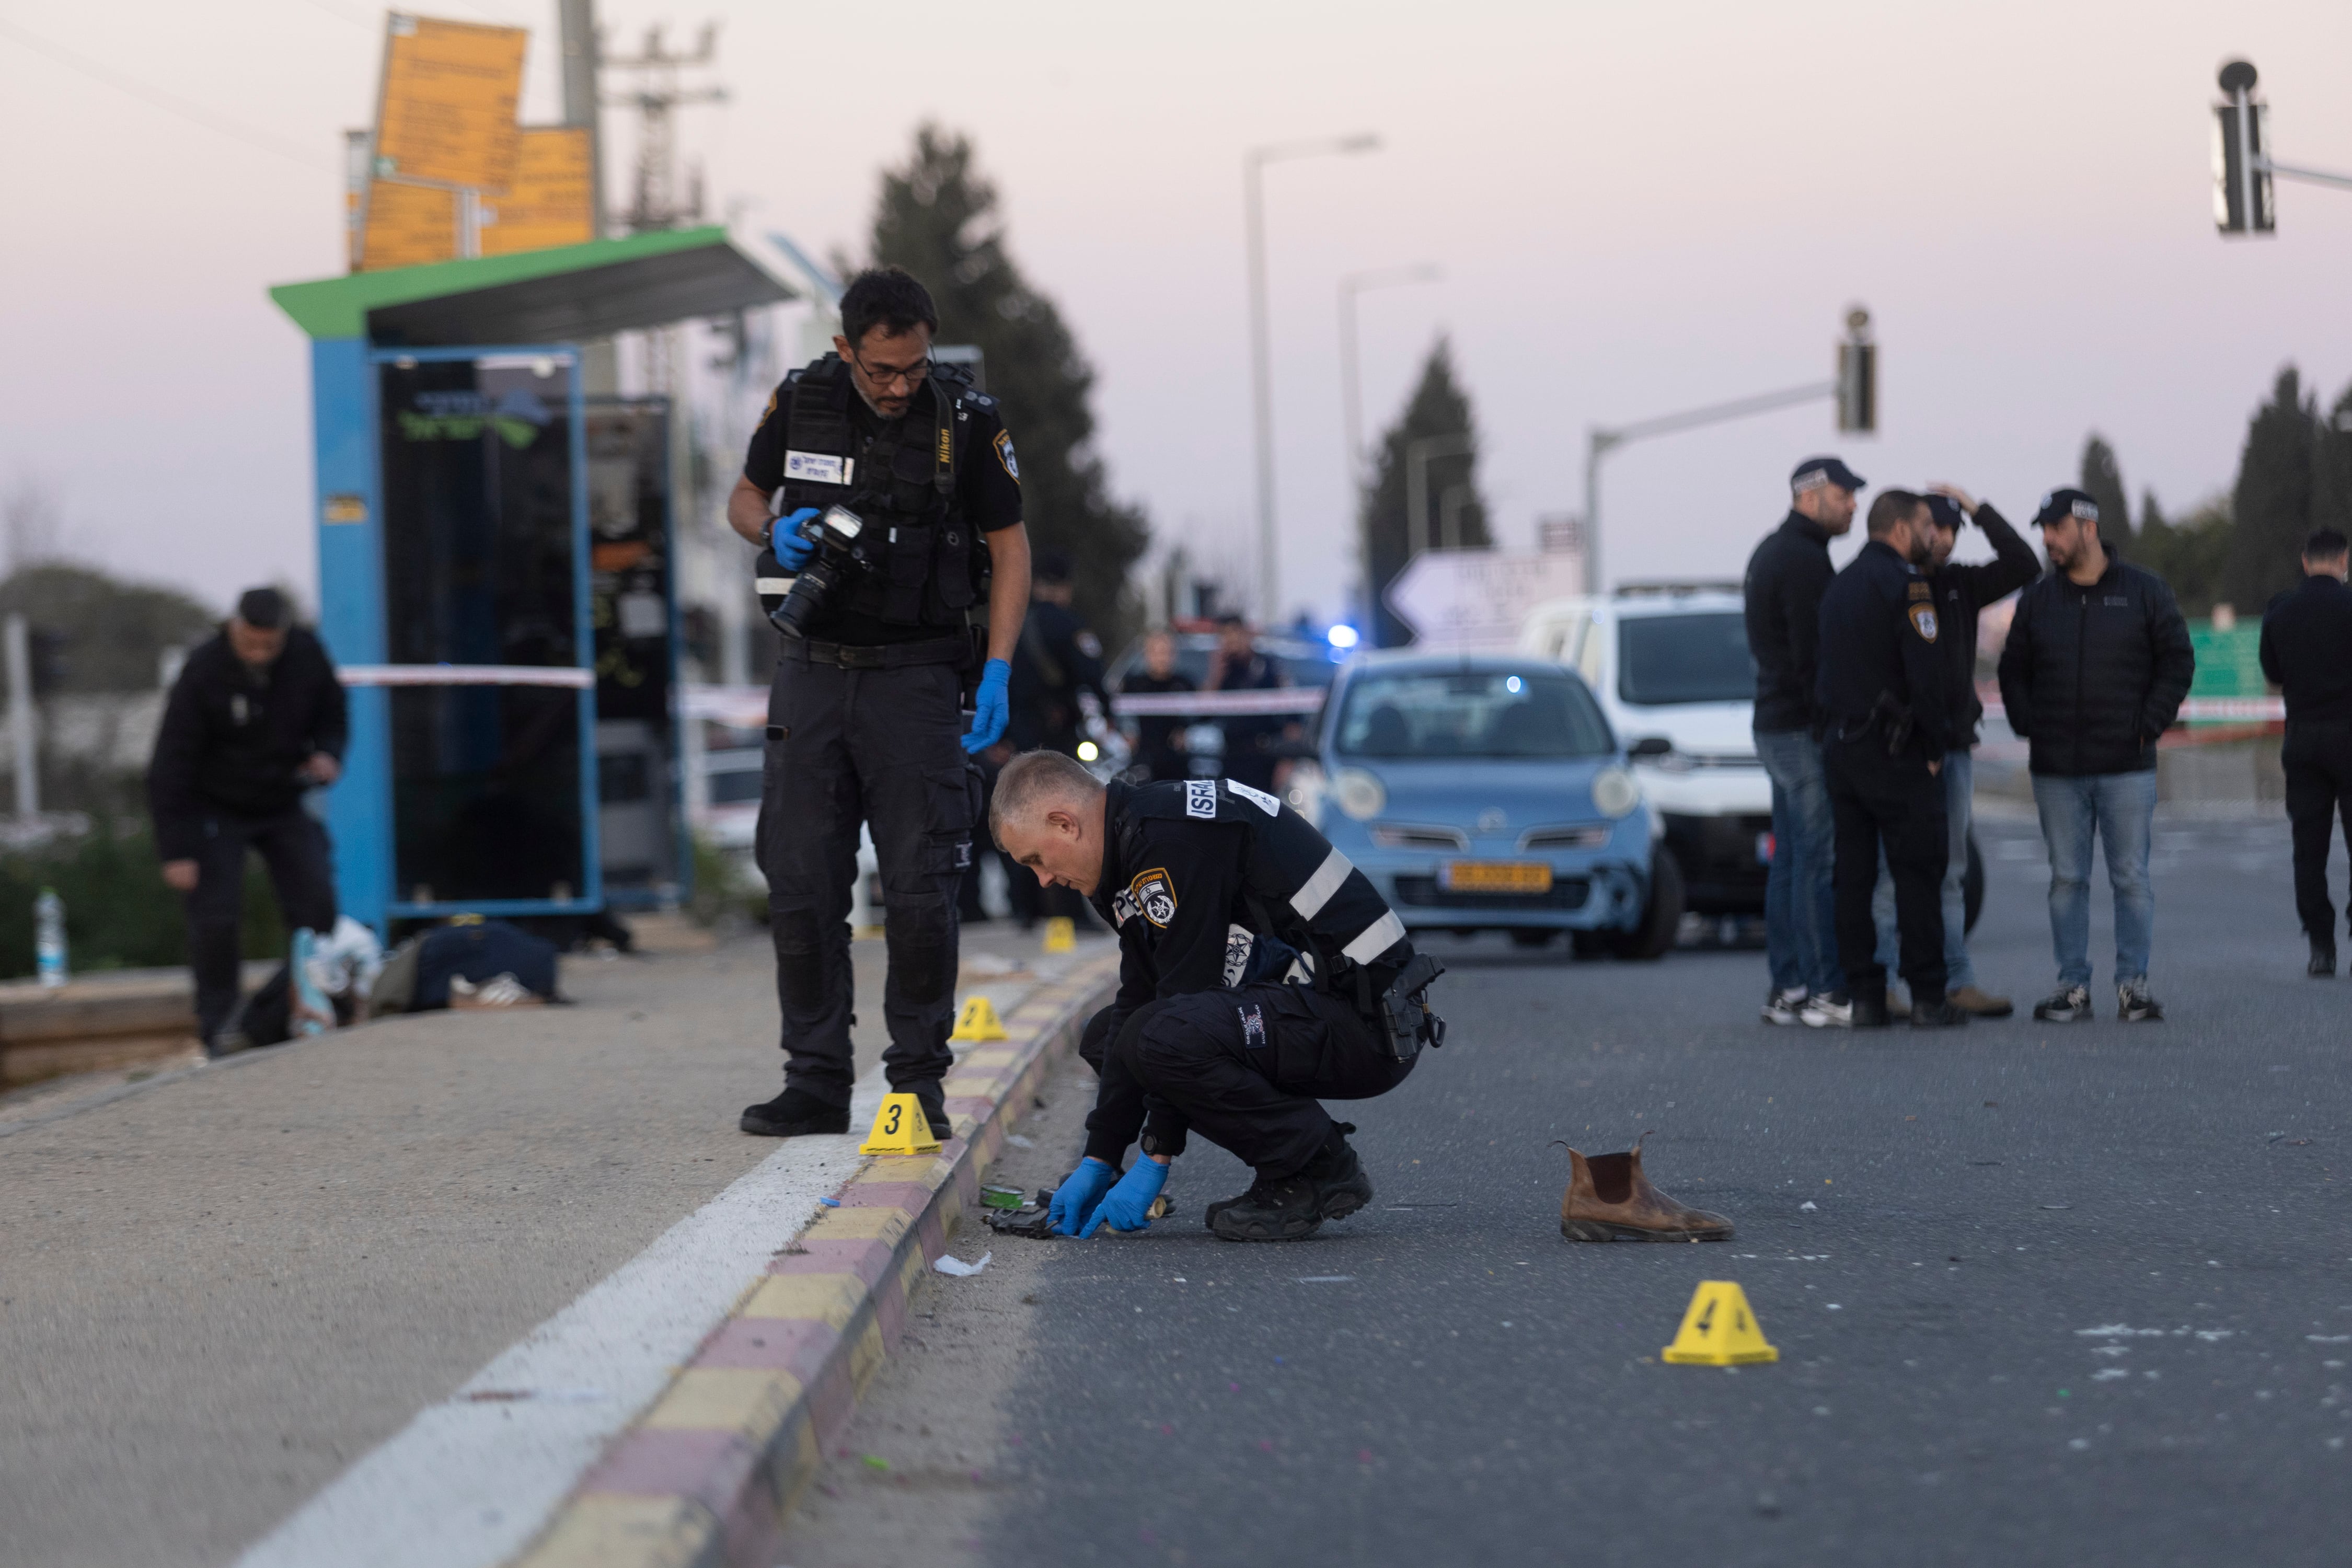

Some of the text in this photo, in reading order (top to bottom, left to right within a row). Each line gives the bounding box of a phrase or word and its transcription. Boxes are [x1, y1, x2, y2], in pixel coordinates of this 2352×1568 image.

[939, 428, 950, 463] Nikon
[1191, 781, 1214, 815] ISRA
[1142, 873, 1163, 885] משטרת
[1238, 1007, 1246, 1023] ישראל
[884, 1104, 902, 1135] 3
